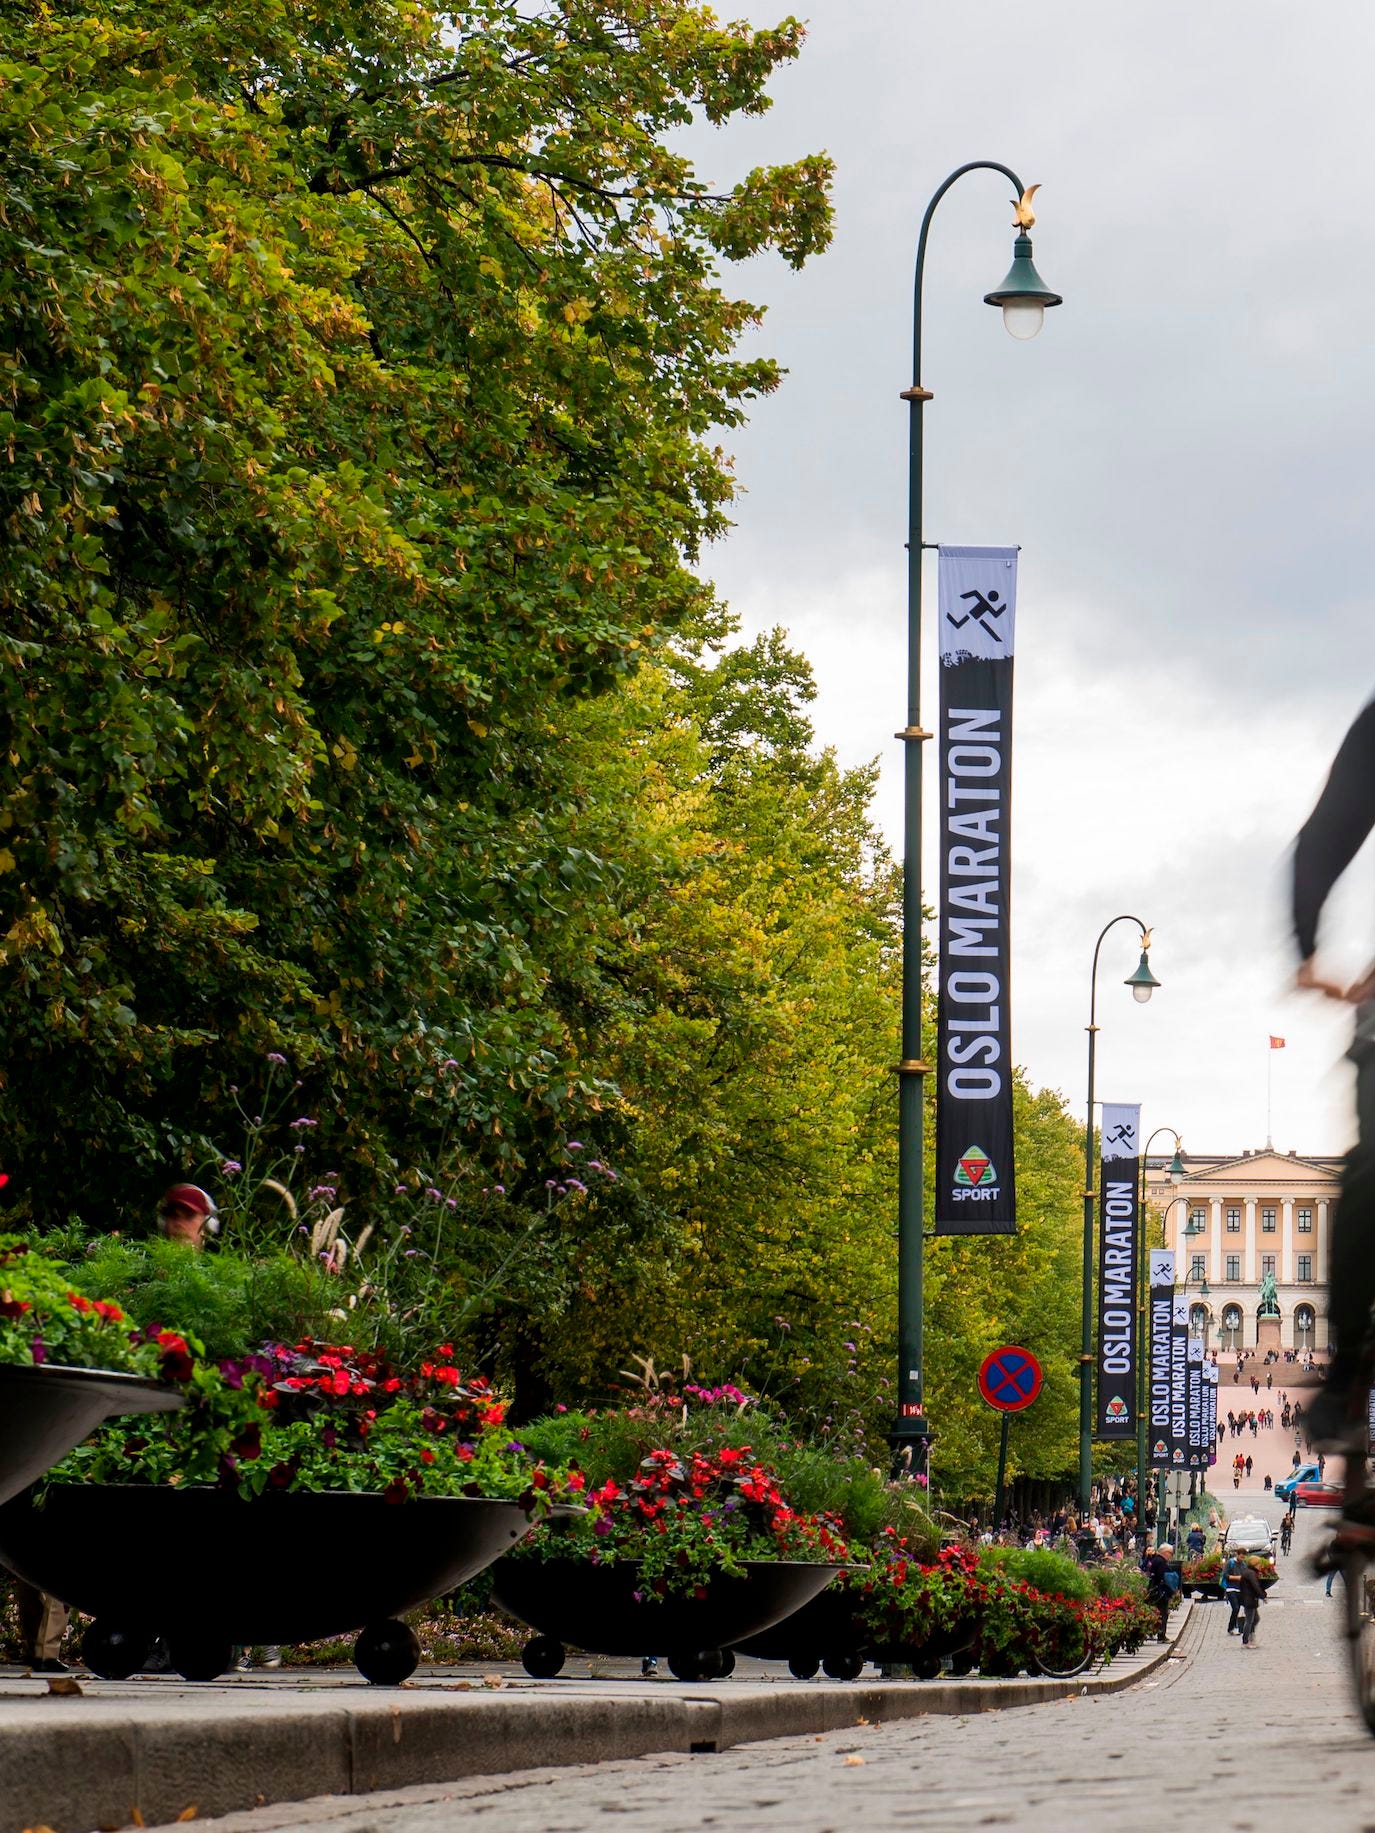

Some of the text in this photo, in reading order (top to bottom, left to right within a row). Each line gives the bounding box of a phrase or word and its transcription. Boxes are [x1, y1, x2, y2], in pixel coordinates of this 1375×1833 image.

[947, 708, 1002, 1101] OSLO MARATON
[952, 1188, 1000, 1201] SPORT
[1102, 1182, 1134, 1375] OSLO MARATON
[1152, 1301, 1171, 1426] OSLO MARATON
[1172, 1337, 1186, 1438] OSLO MARATON
[1189, 1370, 1201, 1446] OSLO MARATON
[1105, 1416, 1129, 1424] SPORT
